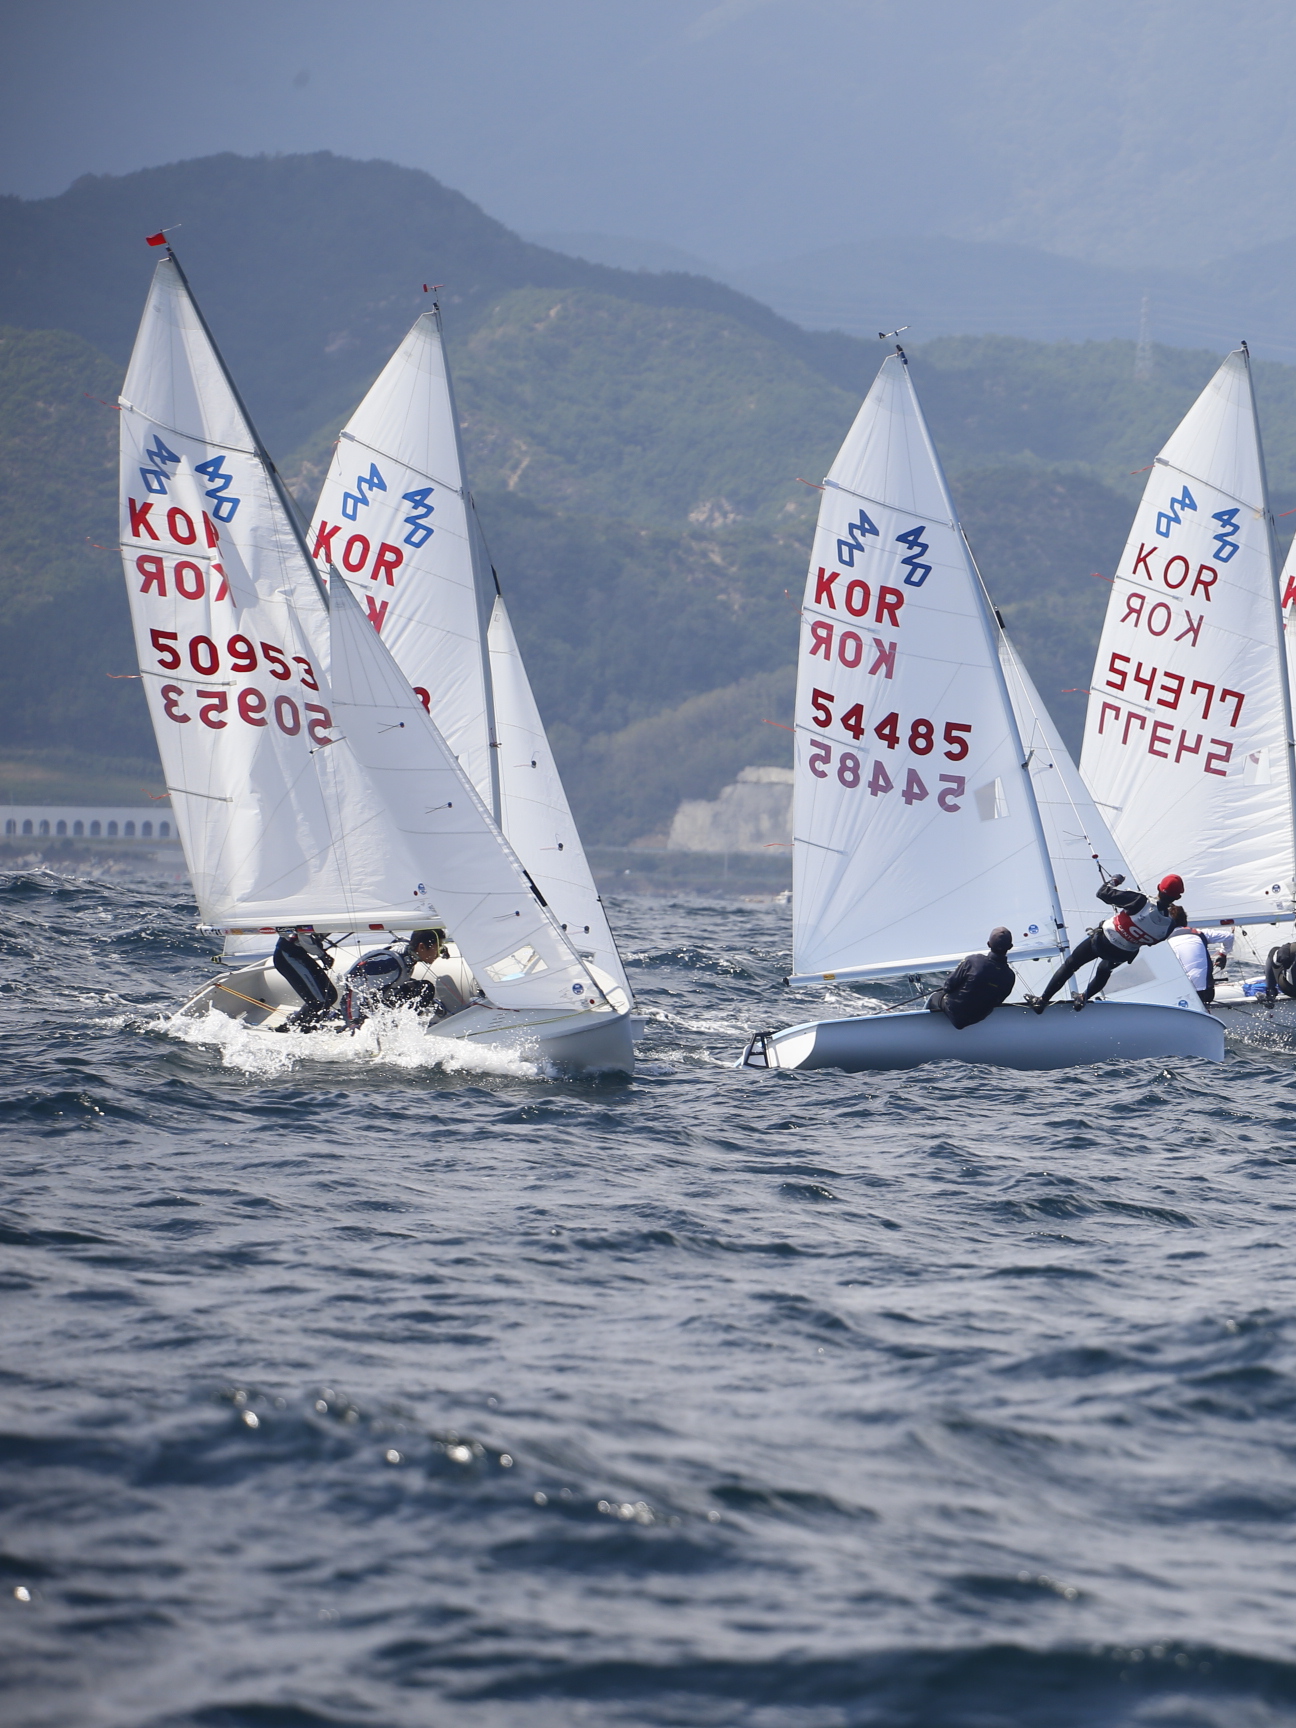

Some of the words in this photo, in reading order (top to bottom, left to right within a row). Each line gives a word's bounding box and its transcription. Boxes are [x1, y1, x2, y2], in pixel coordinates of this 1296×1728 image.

[312, 520, 404, 587] KOR
[1132, 542, 1218, 602] KOR
[814, 566, 905, 628] KOR
[149, 627, 320, 692] 50953
[1105, 652, 1246, 728] 54377
[811, 687, 972, 762] 54485
